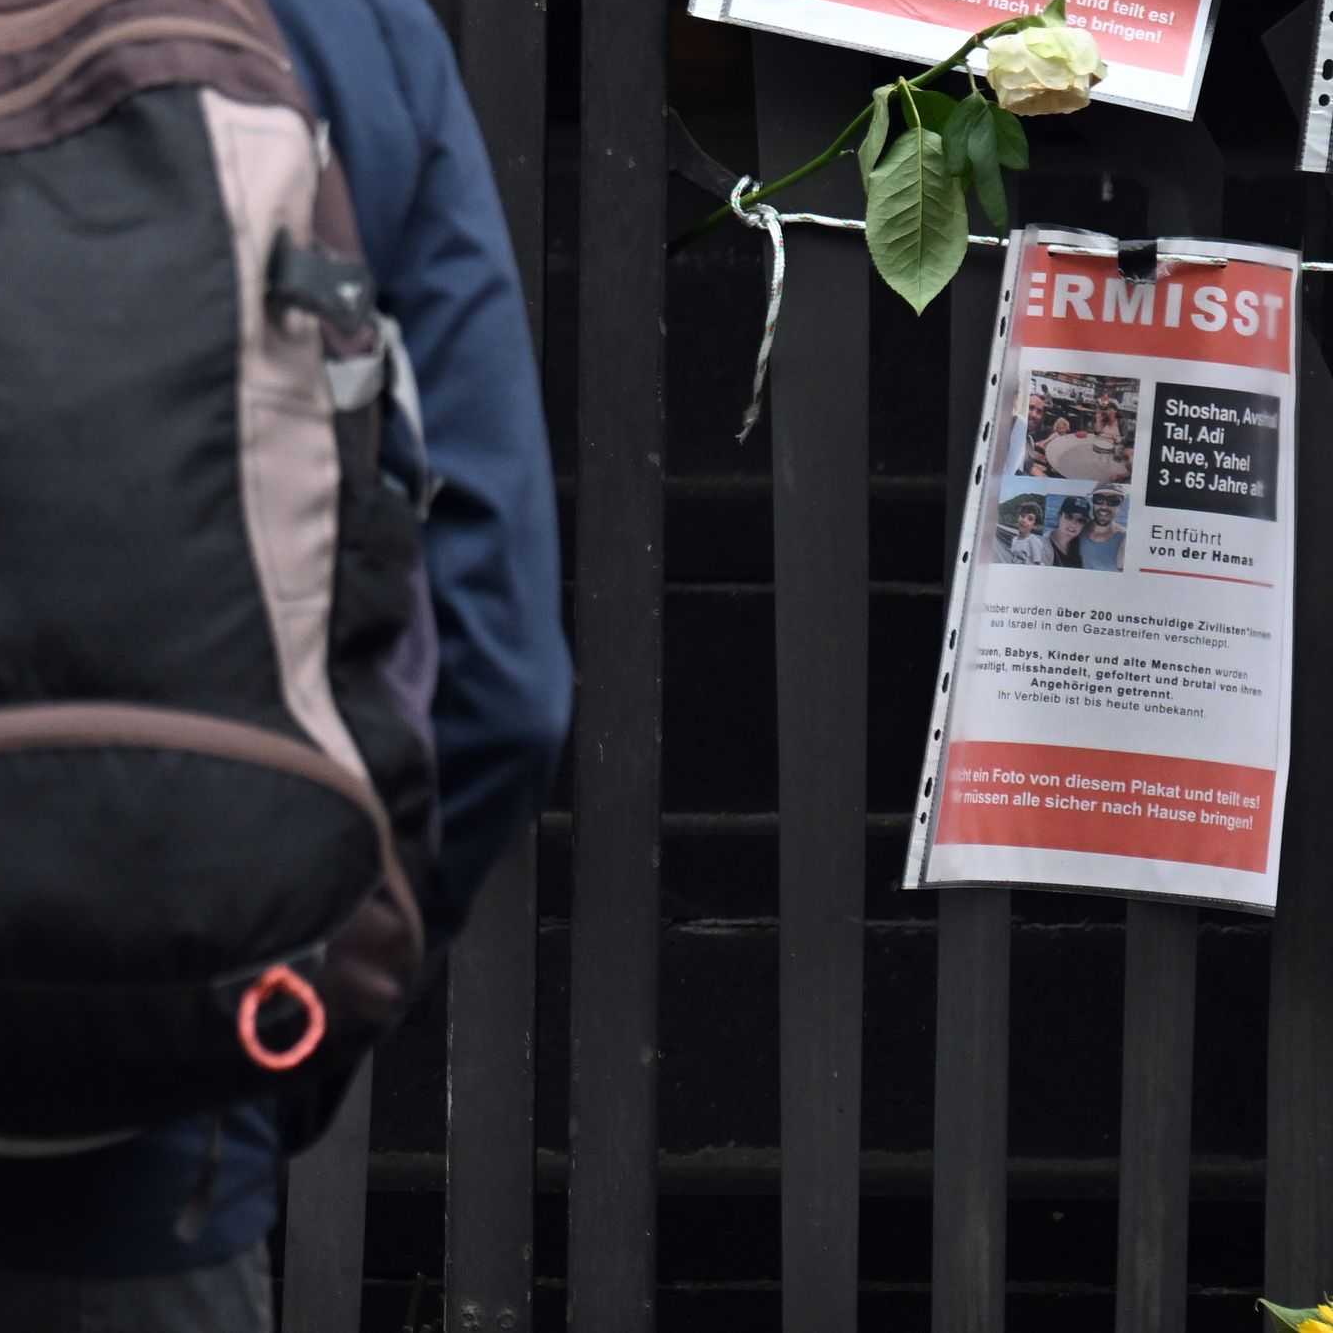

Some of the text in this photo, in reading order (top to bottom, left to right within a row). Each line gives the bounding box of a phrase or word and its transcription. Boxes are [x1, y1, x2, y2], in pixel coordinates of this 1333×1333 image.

[1027, 272, 1283, 340] ERMISST
[1166, 399, 1240, 426] Shoshan,
[1164, 422, 1225, 444] Tal, Adi
[1161, 445, 1250, 472] Nave, Yahel
[1159, 469, 1170, 486] 3
[1185, 471, 1205, 489] 65
[1208, 474, 1248, 495] Jahre
[1151, 524, 1221, 546] Entführt
[1149, 546, 1253, 566] von der Hamas
